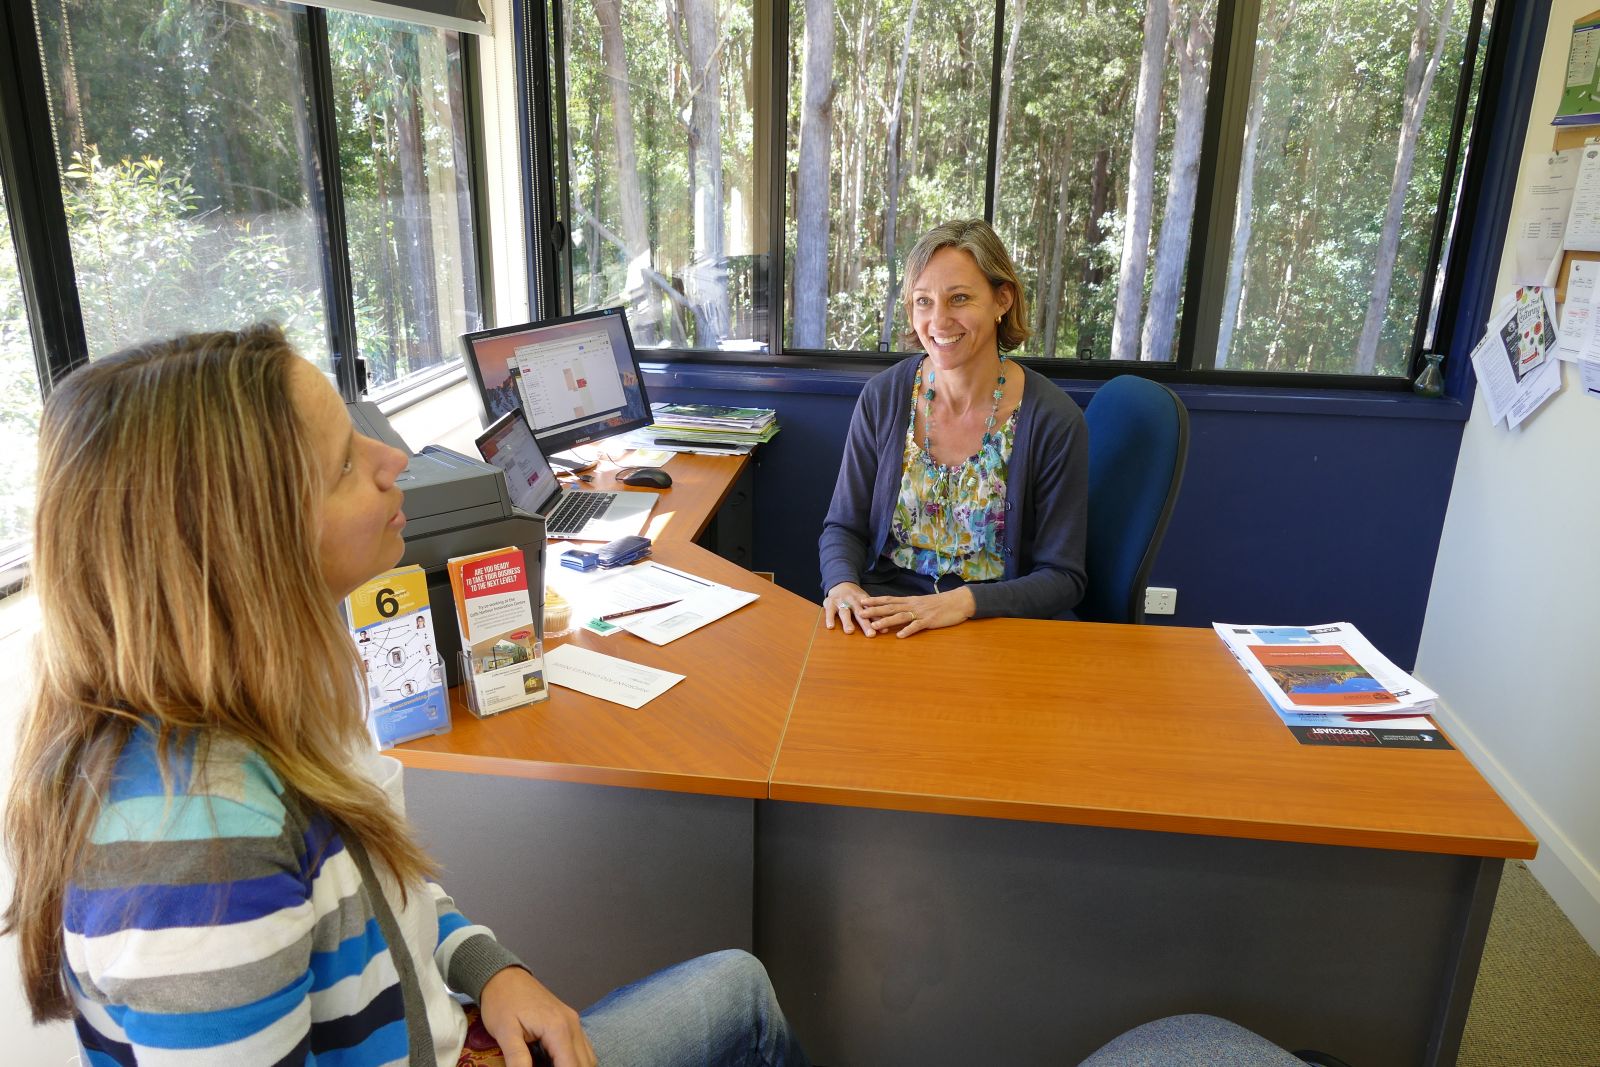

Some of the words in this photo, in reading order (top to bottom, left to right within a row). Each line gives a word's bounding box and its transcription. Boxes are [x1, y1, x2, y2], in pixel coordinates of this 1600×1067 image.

[472, 575, 484, 584] TAKE
[485, 572, 498, 580] YOUR
[498, 567, 520, 577] BUSINESS
[475, 567, 484, 576] ARE
[484, 565, 493, 573] YOU
[494, 562, 509, 571] READY
[478, 582, 486, 590] THE
[487, 579, 499, 588] NEXT
[500, 575, 517, 585] LEVEL?
[376, 588, 399, 618] 6
